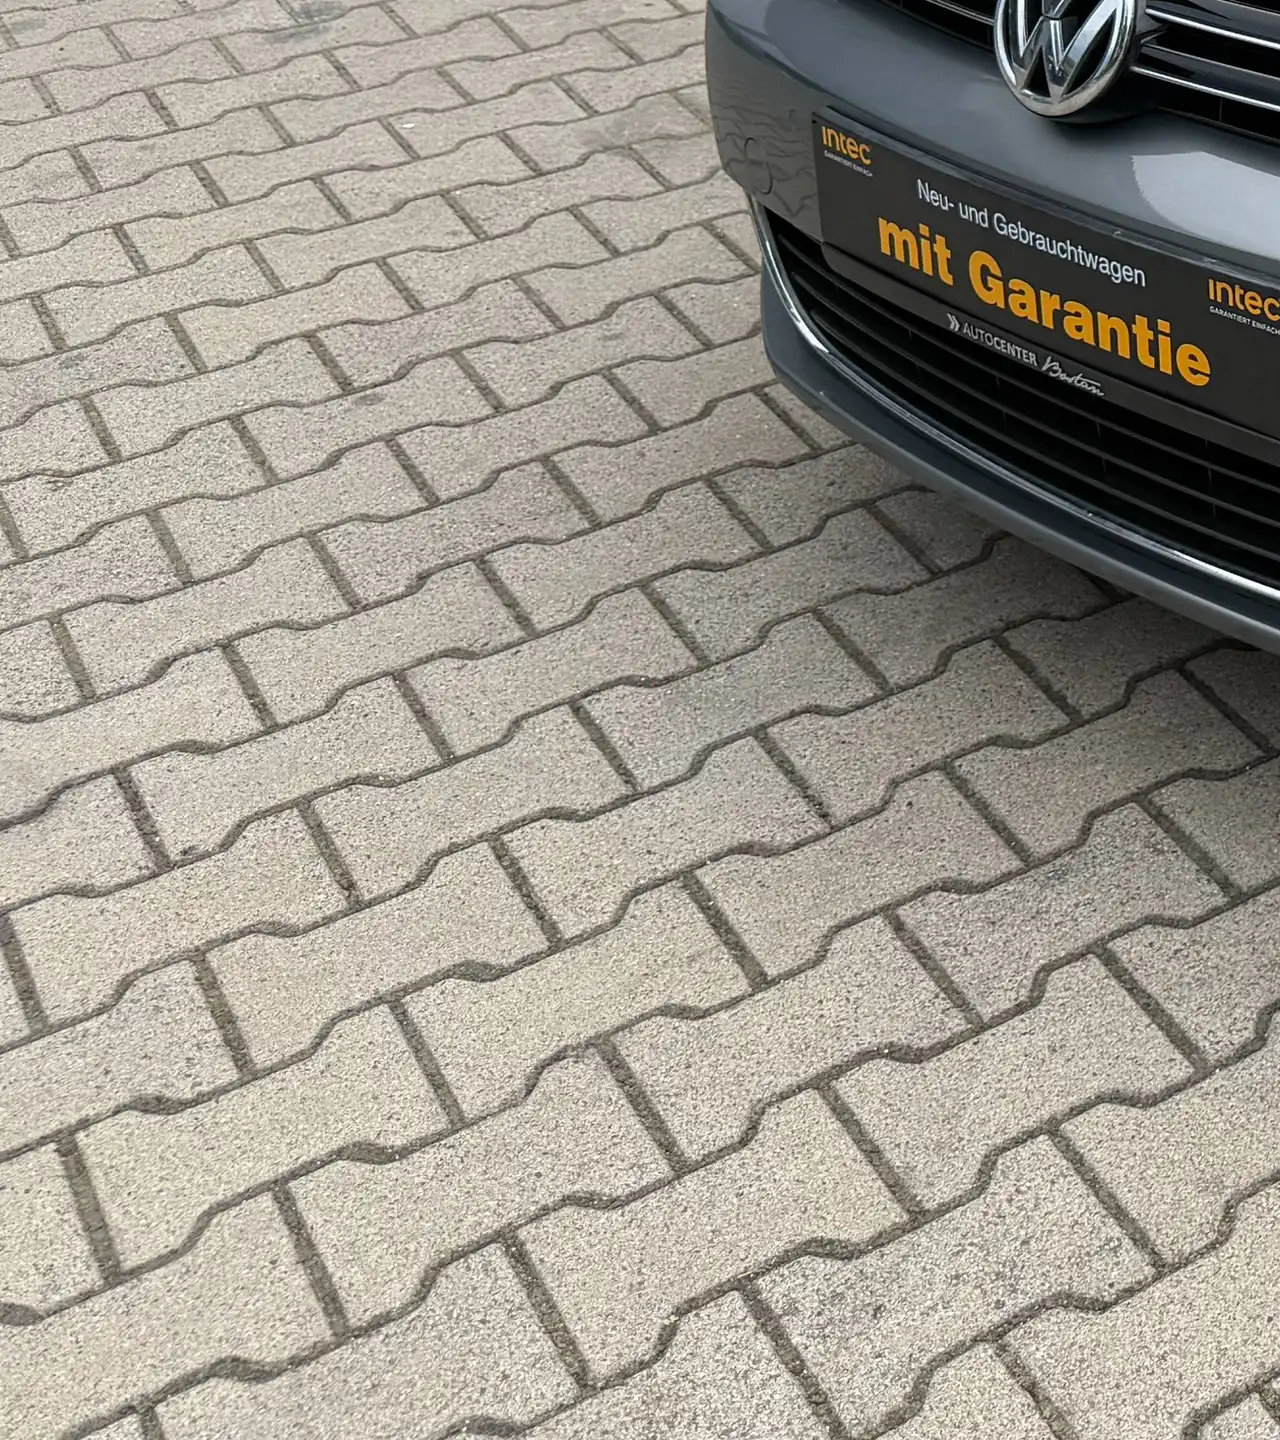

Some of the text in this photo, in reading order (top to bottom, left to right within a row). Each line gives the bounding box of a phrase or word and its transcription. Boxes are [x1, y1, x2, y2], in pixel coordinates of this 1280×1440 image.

[821, 125, 872, 165] intec
[917, 178, 1146, 288] Neu- und Gebrauchtwagen
[877, 216, 1212, 387] mit Garantie
[1208, 278, 1280, 322] intec
[1209, 305, 1280, 335] GARANTIERT EINFACH
[963, 322, 1038, 367] AUTOCENTER
